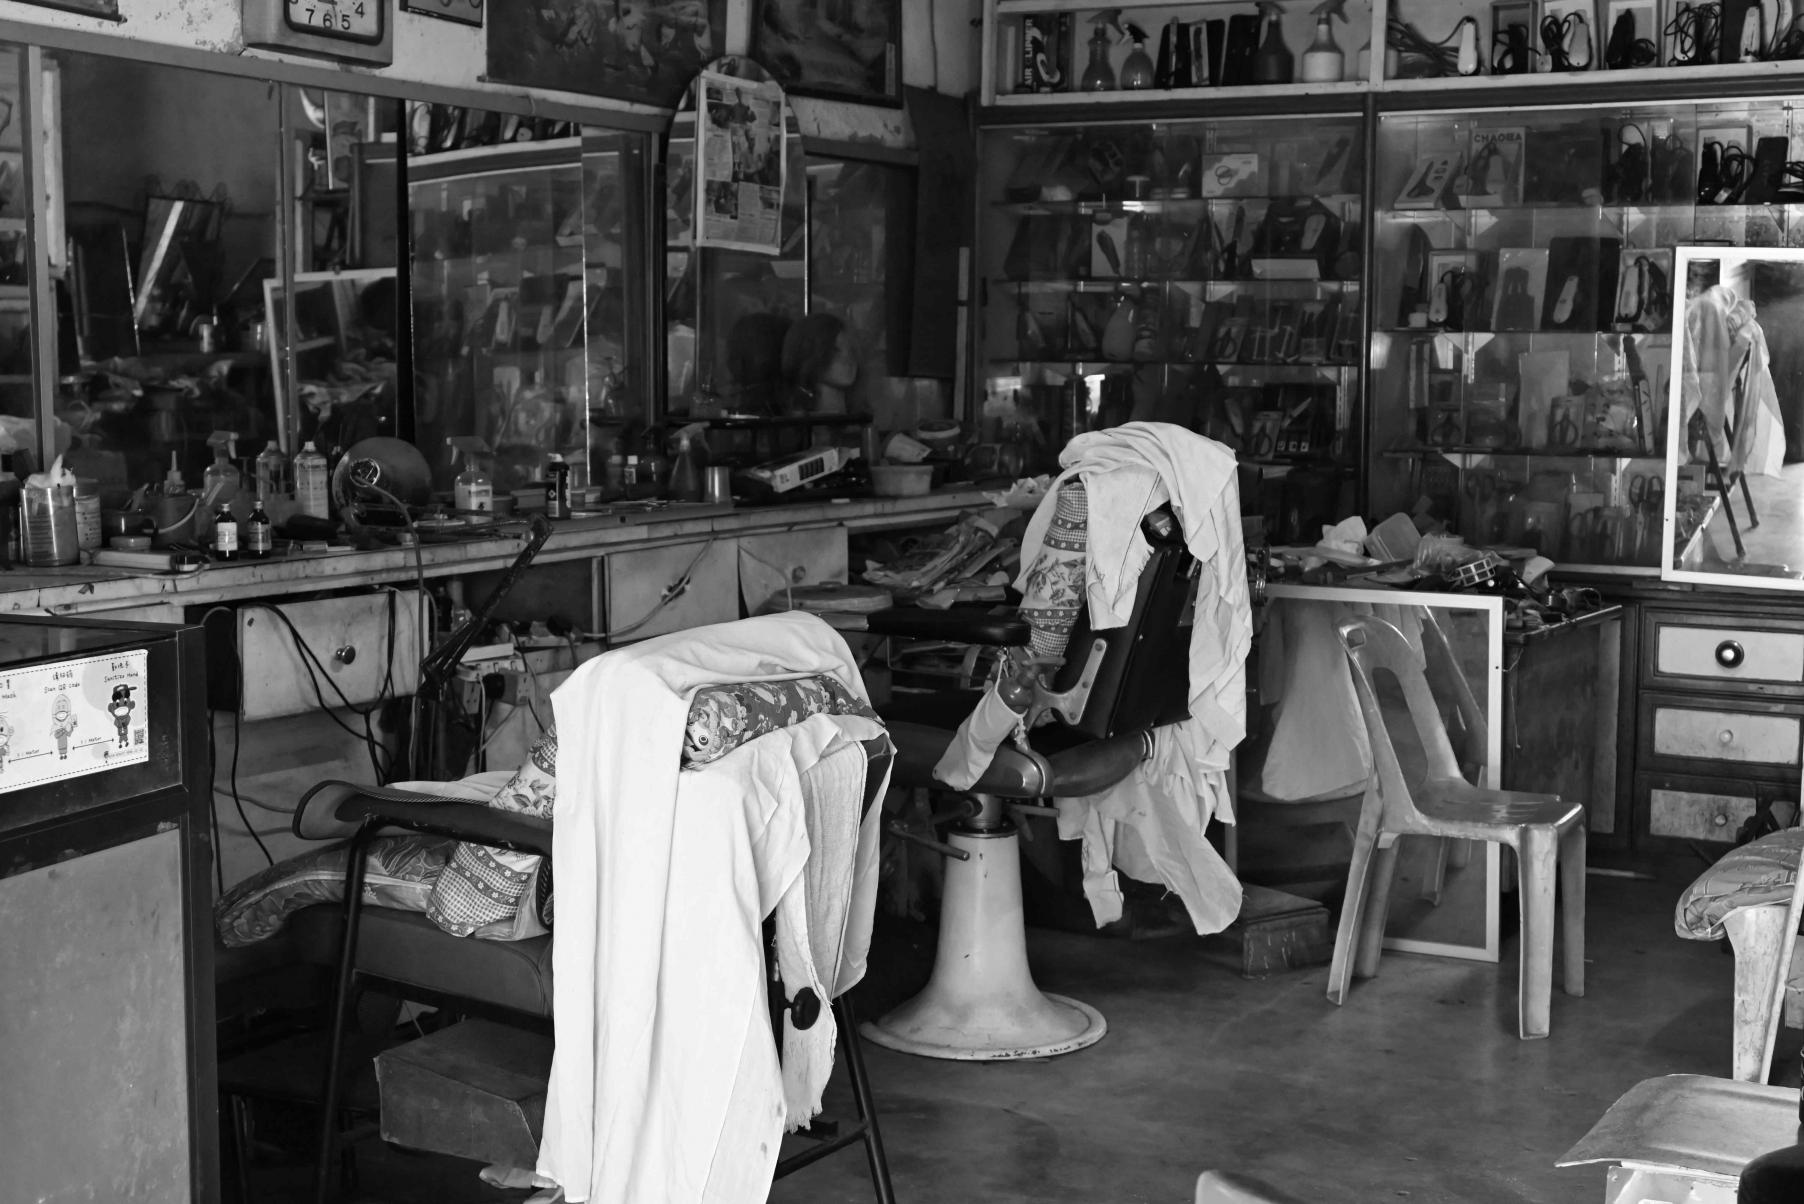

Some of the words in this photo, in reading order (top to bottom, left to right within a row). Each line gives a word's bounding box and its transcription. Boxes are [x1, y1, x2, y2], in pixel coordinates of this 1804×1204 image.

[305, 8, 315, 24] 7
[355, 2, 365, 18] 4
[323, 12, 332, 29] 6
[341, 14, 350, 30] 5
